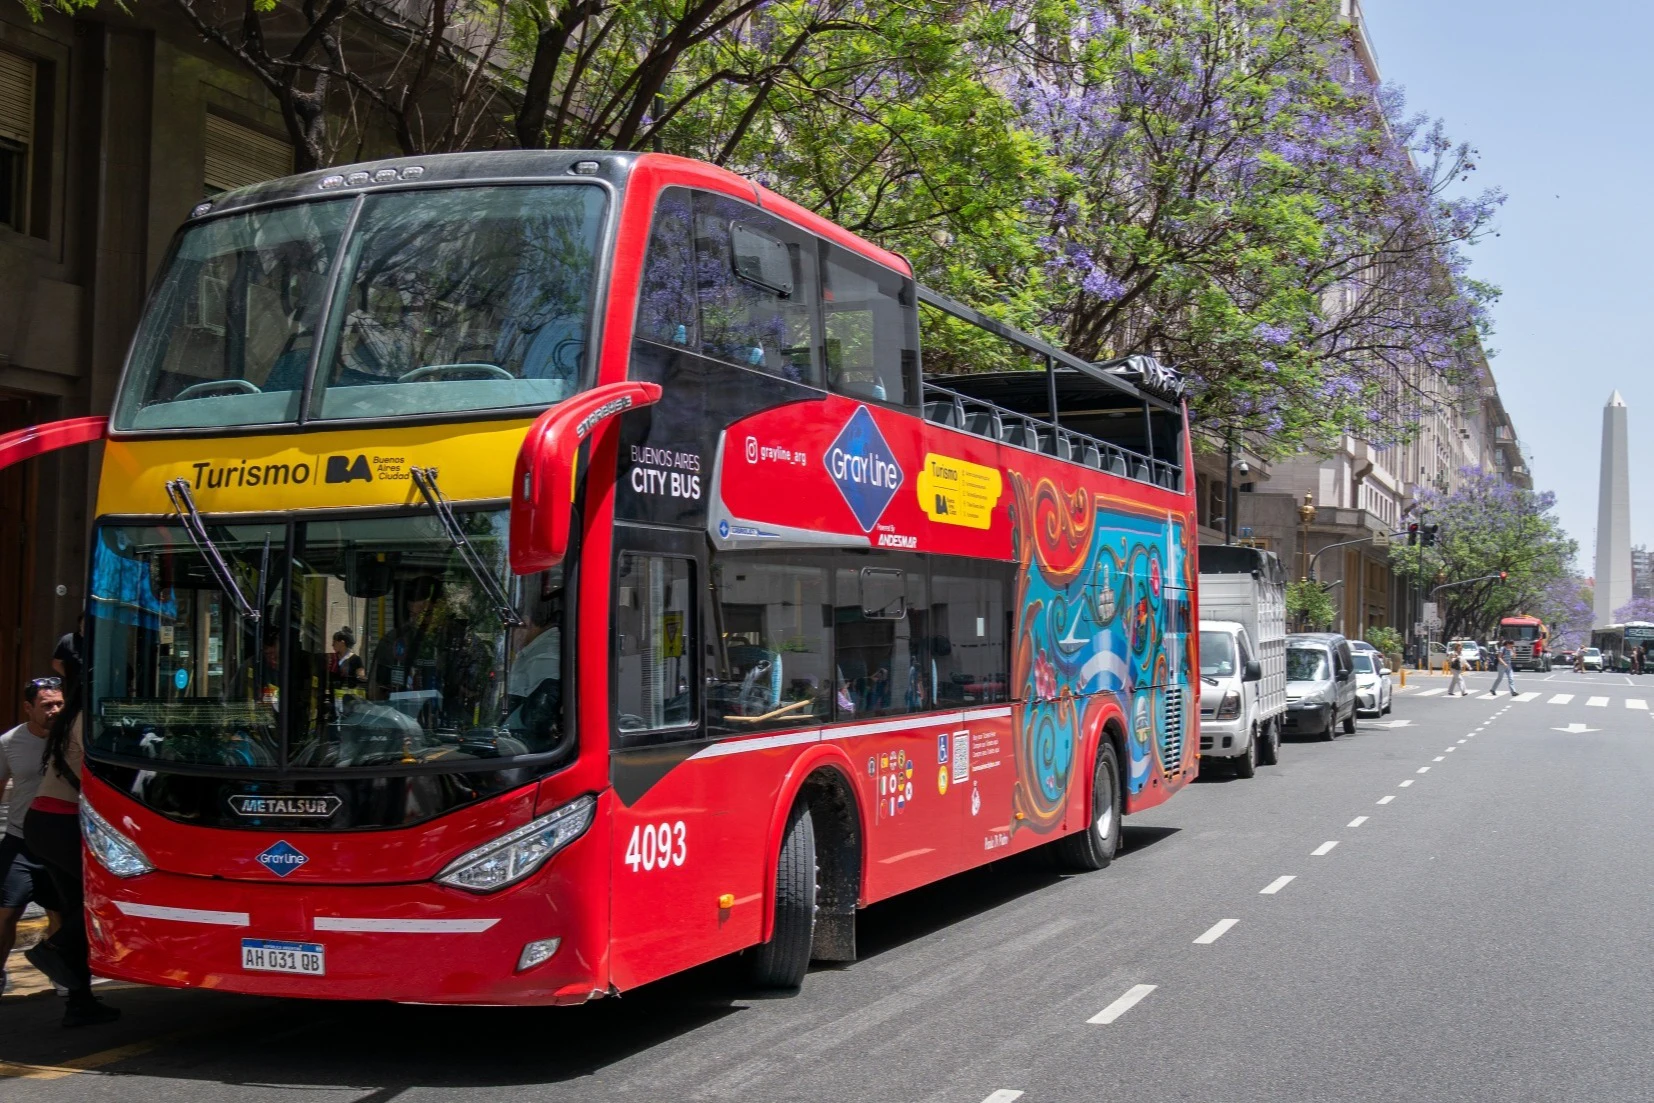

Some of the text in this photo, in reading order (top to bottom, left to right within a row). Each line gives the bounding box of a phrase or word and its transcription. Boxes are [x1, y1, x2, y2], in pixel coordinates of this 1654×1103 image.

[372, 456, 405, 465] Buenos
[630, 445, 700, 471] BUENOS AIRES
[760, 446, 806, 467] grayline_arg
[192, 454, 373, 490] Turismo BA
[377, 464, 401, 472] Aires
[378, 471, 410, 481] Ciudad
[931, 461, 958, 481] Turismo
[631, 467, 701, 500] CITY BUS
[878, 533, 918, 549] ANDESMAR
[241, 799, 328, 813] METALSUR
[624, 820, 687, 873] 4093
[245, 949, 320, 972] AH 031 QB
